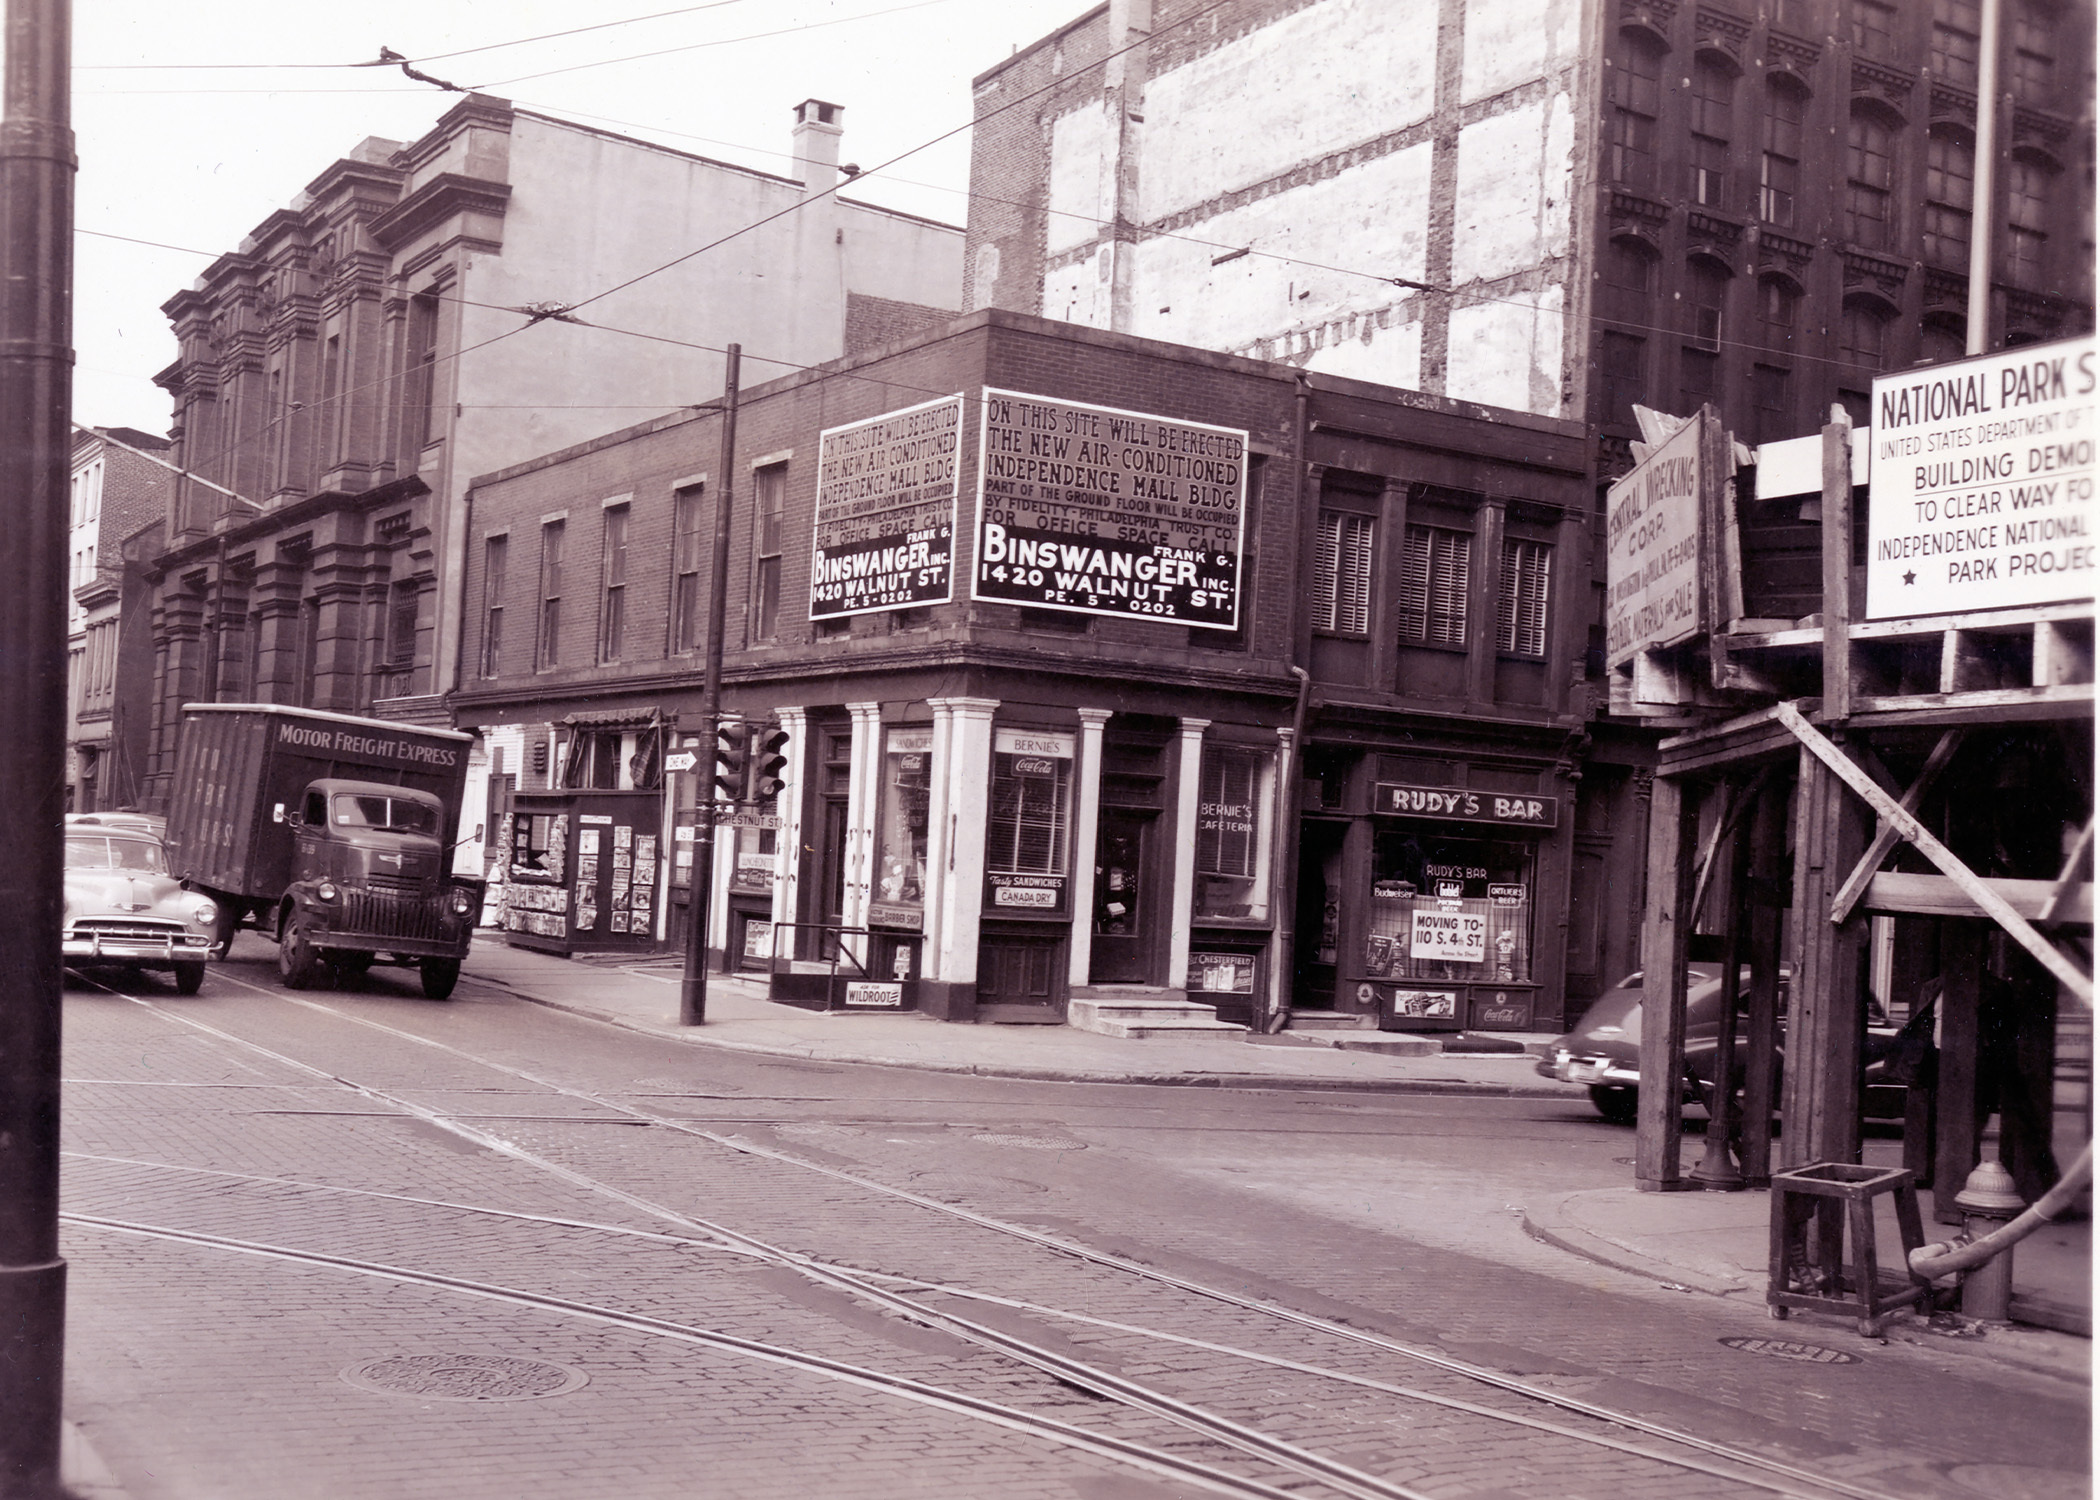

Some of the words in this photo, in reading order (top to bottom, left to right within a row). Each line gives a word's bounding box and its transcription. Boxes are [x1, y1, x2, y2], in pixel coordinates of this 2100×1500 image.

[1882, 373, 1991, 430] NATIONAL
[2001, 357, 2067, 409] PARK
[823, 437, 836, 458] ON
[839, 431, 859, 455] THIS
[861, 425, 883, 450] SITE
[886, 419, 905, 443] WILL
[908, 414, 920, 438] BE
[922, 404, 959, 434] ERECTED
[989, 399, 1011, 424] ON
[1019, 403, 1057, 431] THIS
[1065, 411, 1099, 437] SITE
[1108, 418, 1149, 446] WILL
[1158, 426, 1176, 450] BE
[1181, 430, 1243, 460] ERECTED
[989, 426, 1022, 453] THE
[1030, 433, 1071, 459] NEW
[1880, 436, 1922, 460] UNITED
[1927, 427, 1973, 453] STATES
[1978, 411, 2061, 445] DEPARTMENT
[822, 460, 838, 482] THE
[842, 453, 865, 478] NEW
[890, 432, 957, 466] CONDITIONED
[1915, 452, 2014, 490] BUILDING
[820, 473, 885, 507] INDEPENDENCE
[889, 465, 918, 491] MALL
[923, 457, 955, 484] BLDG.
[852, 500, 875, 515] GROUND
[923, 482, 954, 500] OCCUPIED
[987, 453, 1119, 494] INDEPENDENCE
[1133, 475, 1179, 502] MALL
[1188, 484, 1239, 511] BLDG.
[985, 478, 1016, 494] PART
[1020, 484, 1034, 497] OF
[1040, 486, 1060, 501] THE
[1065, 490, 1111, 507] GROUND
[1116, 497, 1151, 513] FLOOR
[1155, 503, 1177, 517] WILL
[1182, 507, 1192, 519] BE
[1196, 509, 1239, 525] OCCUPIED
[985, 494, 1002, 508] BY
[1169, 521, 1209, 537] TRUST
[1215, 527, 1236, 541] CO.
[1609, 482, 1642, 554] CENTRAL
[1646, 457, 1695, 508] WRECKING
[1914, 500, 1937, 523] TO
[1944, 491, 2001, 519] CLEAR
[2009, 482, 2059, 510] WAY
[817, 535, 832, 550] FOR
[840, 528, 870, 545] OFFICE
[879, 519, 915, 537] SPACE
[923, 511, 952, 529] CALL
[907, 529, 936, 544] FRANK
[941, 526, 951, 538] G.
[984, 508, 1016, 527] FOR
[1037, 516, 1098, 537] OFFICE
[1118, 527, 1169, 547] SPACE
[1188, 537, 1234, 556] CALL
[1628, 511, 1666, 557] CORP.
[1877, 525, 1998, 561] INDEPENDENCE
[2005, 515, 2090, 546] NATIONAL
[814, 541, 930, 585] BINSWANGER
[930, 552, 950, 566] INC.
[984, 523, 1199, 588] BINSWANGER
[1202, 577, 1235, 592] INC.
[1153, 546, 1206, 563] FRANK
[1216, 555, 1233, 567] G.
[1948, 557, 1998, 583] PARK
[813, 583, 842, 603] 1420
[845, 571, 912, 597] WALNUT
[918, 566, 945, 587] ST.
[982, 563, 1044, 587] 1420
[1054, 571, 1173, 602] WALNUT
[1190, 590, 1232, 611] ST.
[1045, 590, 1074, 603] PE.
[844, 598, 859, 609] PE.
[279, 724, 331, 749] MOTOR
[334, 731, 396, 757] FREIGHT
[397, 741, 457, 766] EXPRESS
[1014, 739, 1060, 753] BERNIE'S
[1201, 803, 1252, 818] BERNIE'S
[1393, 789, 1480, 815] RUDY'S
[1494, 797, 1544, 819] BAR
[1200, 820, 1253, 832] CAFETERIA
[989, 876, 1012, 888] Tasty
[1013, 877, 1062, 887] SANDWICHES
[1426, 864, 1463, 878] RUDY'S
[1466, 867, 1487, 880] BAR
[1001, 892, 1034, 902] CANADA
[1036, 893, 1052, 902] DRY
[1374, 887, 1415, 899] Budweiser
[907, 914, 920, 925] SHOP
[1417, 916, 1458, 929] MOVING
[1416, 931, 1432, 944] 110
[1436, 931, 1447, 945] S.
[1466, 934, 1483, 948] ST.
[1199, 954, 1250, 965] CHESTERFIELD
[848, 990, 891, 1003] WILDROOT
